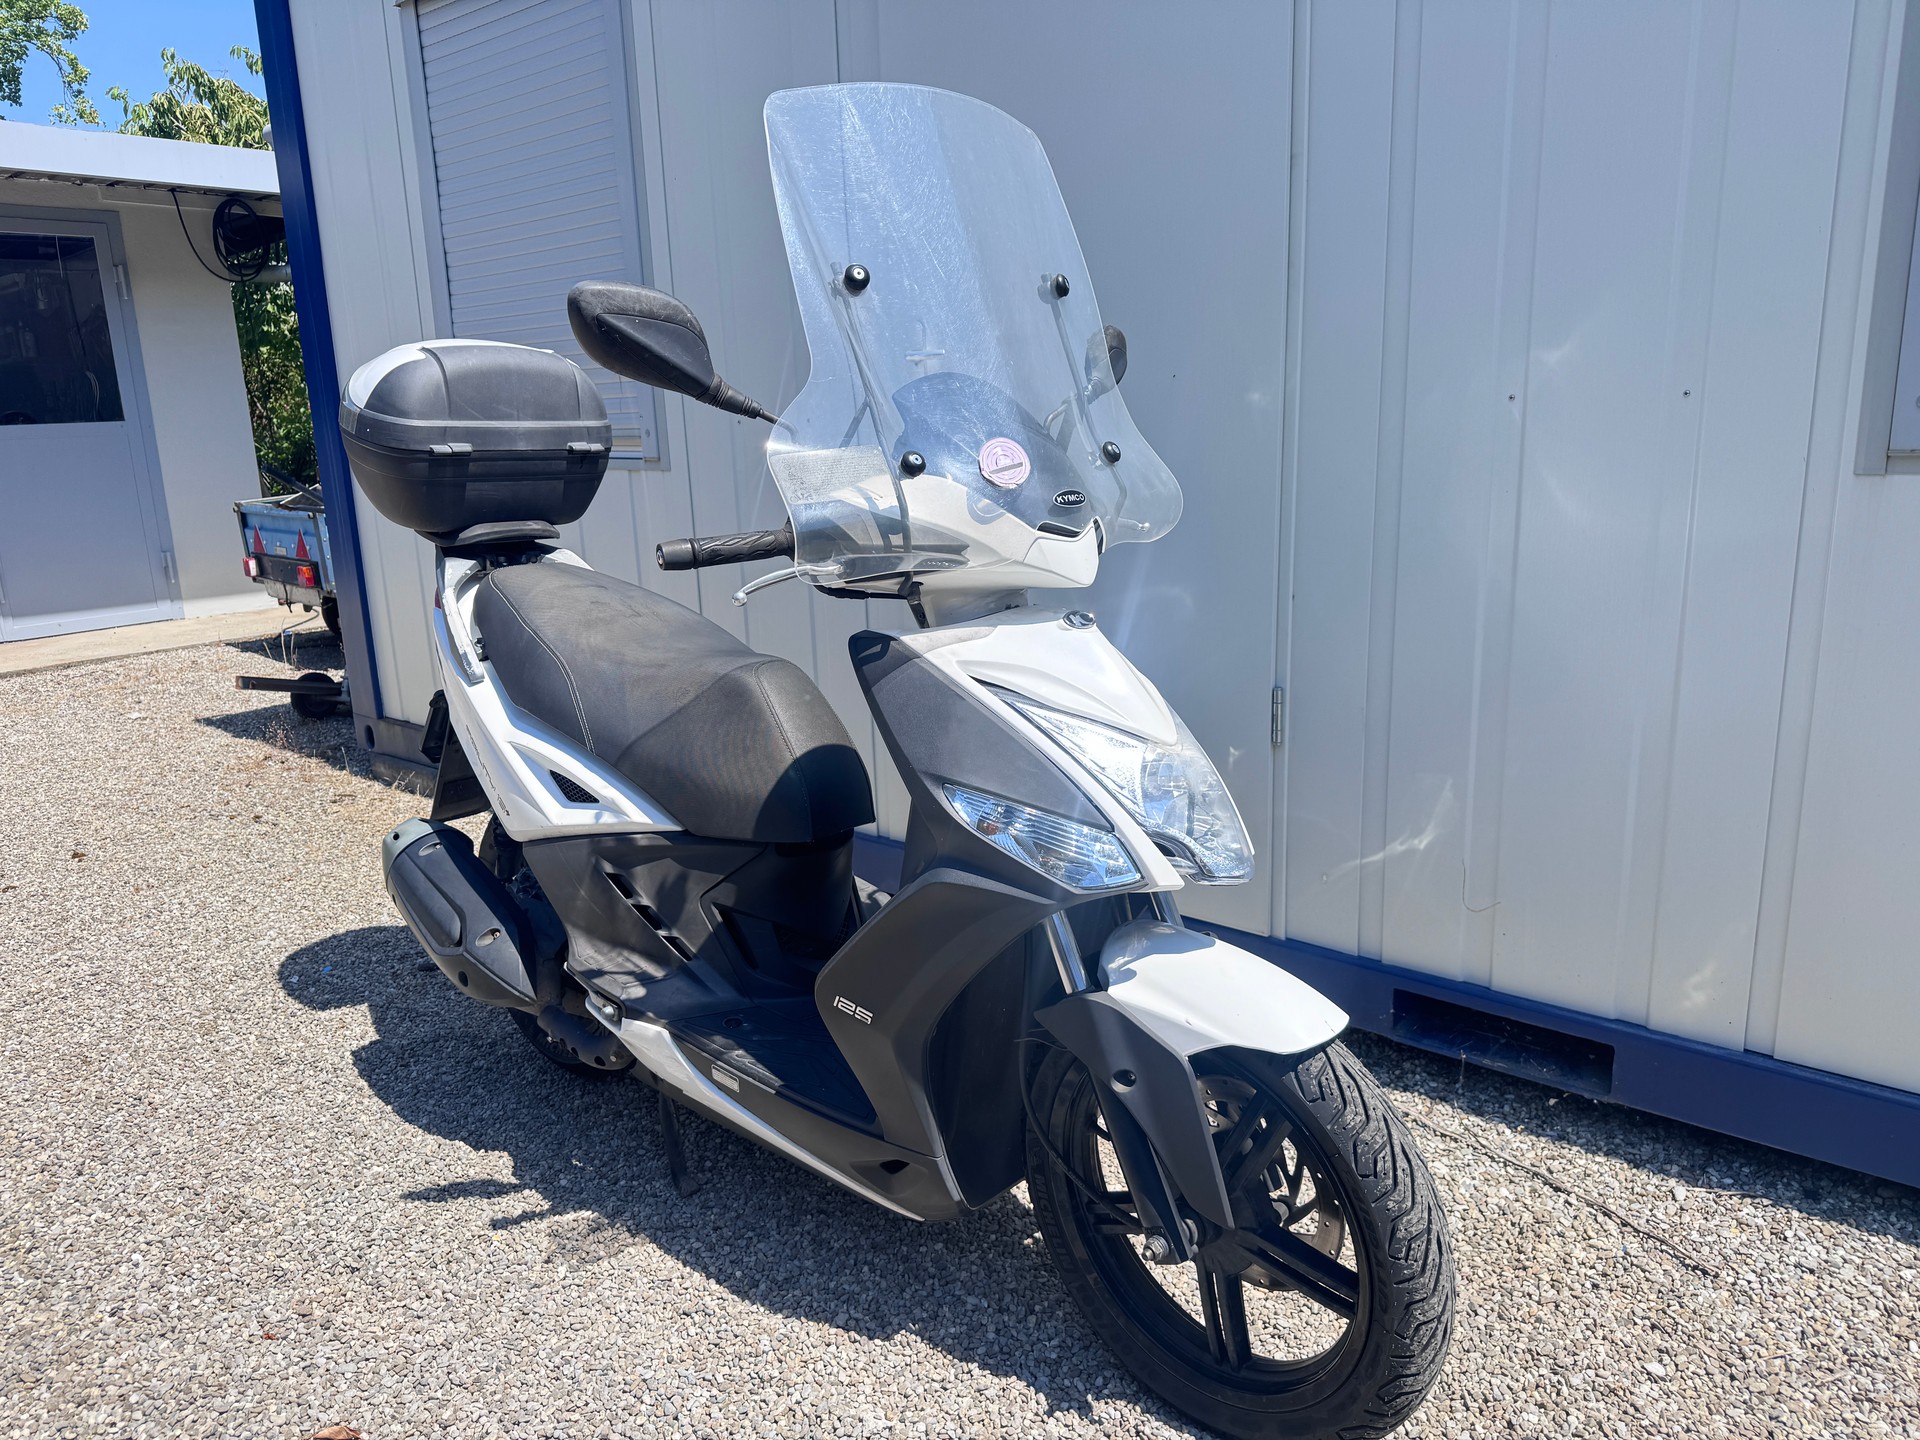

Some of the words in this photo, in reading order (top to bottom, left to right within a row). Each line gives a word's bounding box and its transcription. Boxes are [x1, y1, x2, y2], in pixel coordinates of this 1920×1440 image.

[1056, 493, 1085, 504] KYMCO
[833, 995, 874, 1025] 125
[1034, 1173, 1075, 1271] MICHELIN
